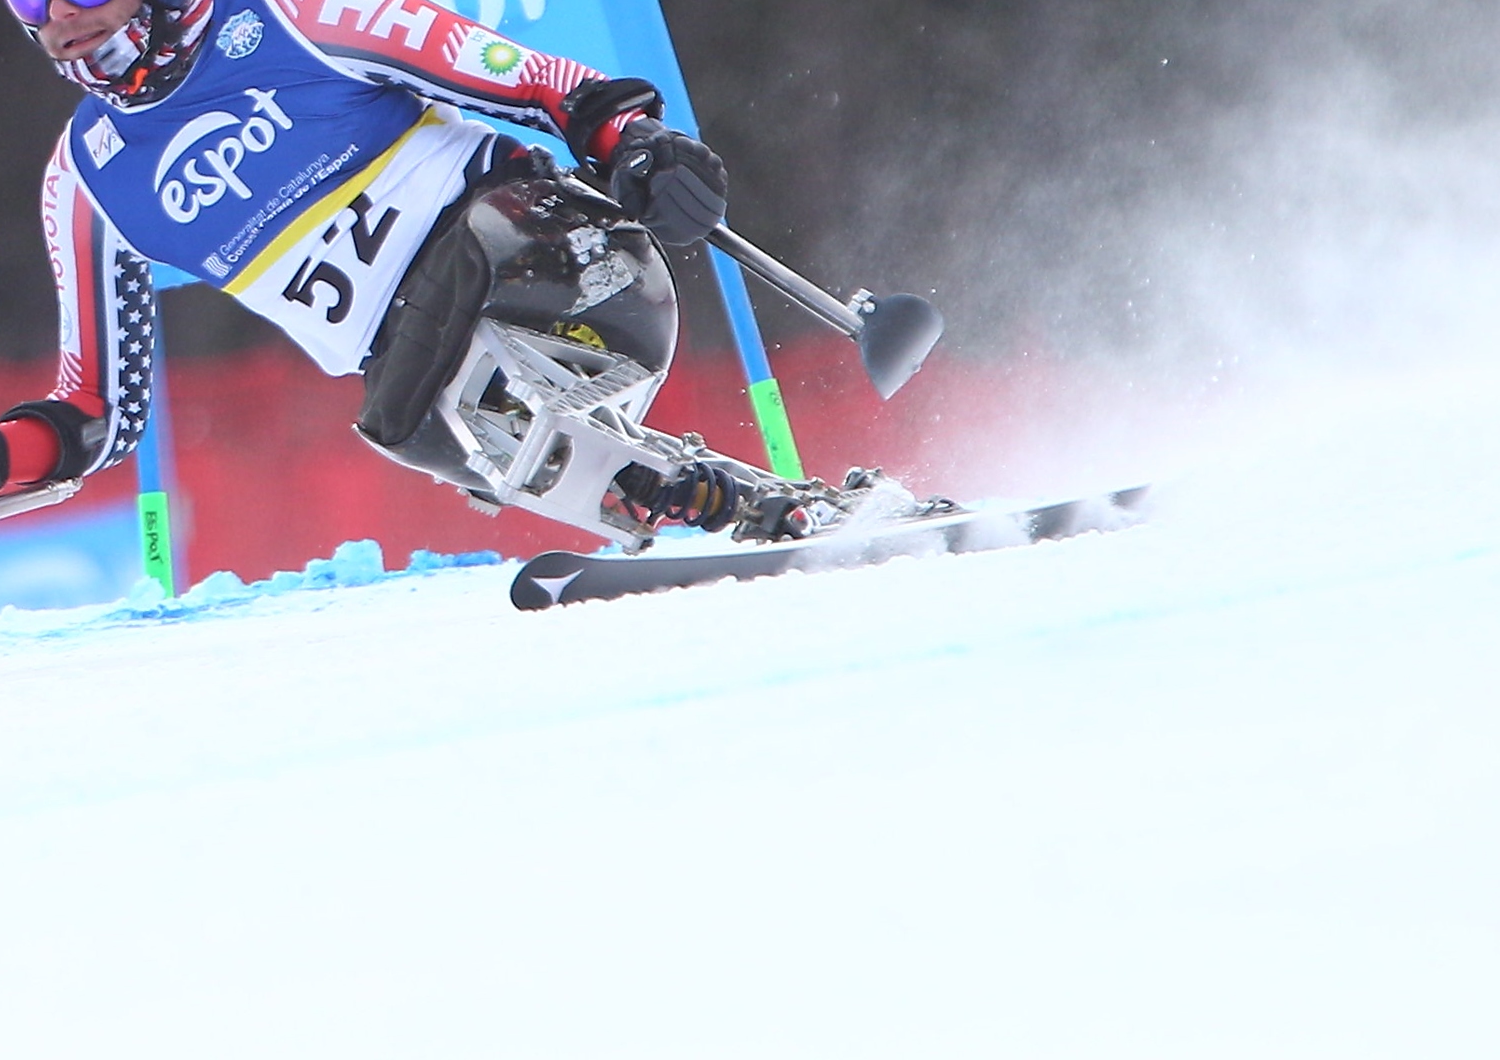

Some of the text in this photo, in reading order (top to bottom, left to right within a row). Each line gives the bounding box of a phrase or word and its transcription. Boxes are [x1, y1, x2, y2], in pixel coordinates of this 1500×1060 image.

[160, 88, 294, 224] espot
[279, 152, 331, 198] Catalunya
[282, 191, 401, 324] 52
